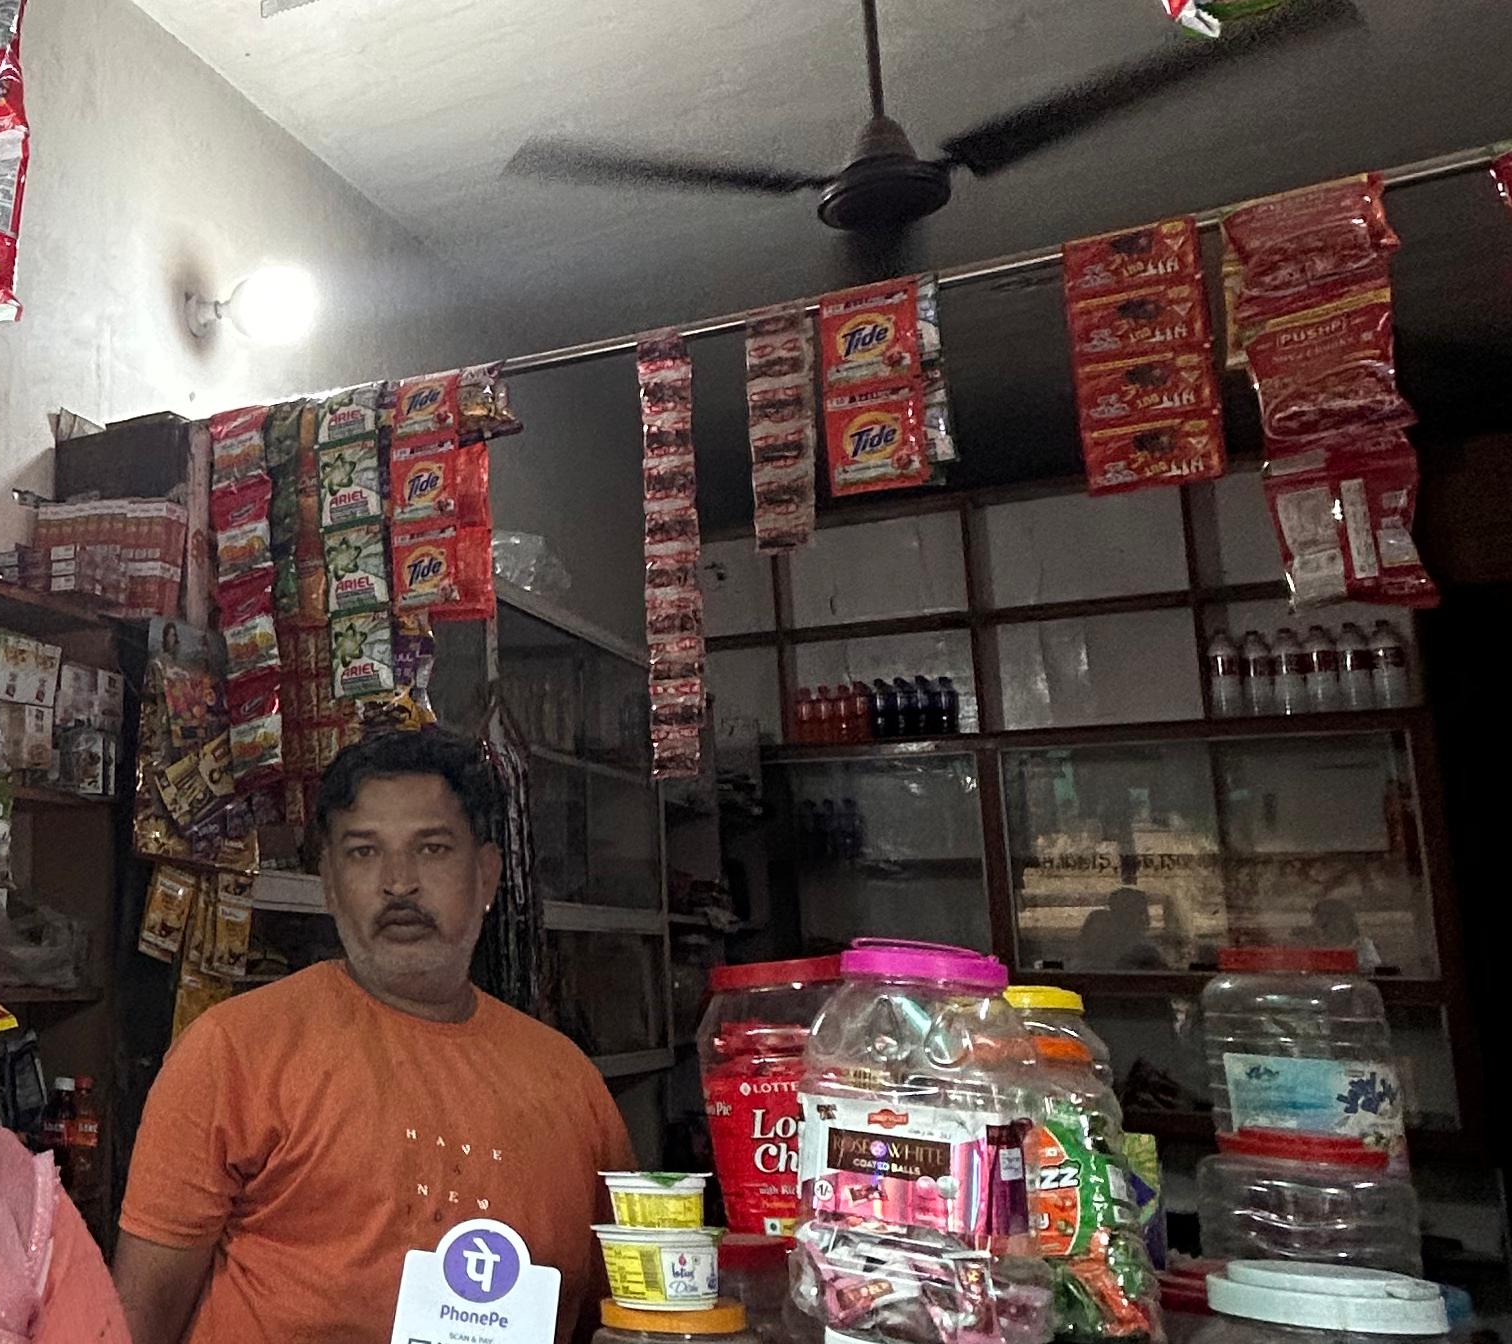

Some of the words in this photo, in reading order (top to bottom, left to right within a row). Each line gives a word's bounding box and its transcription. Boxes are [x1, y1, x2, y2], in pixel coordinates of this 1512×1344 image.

[841, 323, 889, 359] Tide
[403, 386, 447, 415] Tide
[327, 408, 366, 426] ARIEL
[849, 424, 898, 459] Tide
[1168, 457, 1205, 477] HIT
[328, 490, 369, 508] ARIEL
[406, 472, 441, 502] Tide
[336, 576, 375, 592] ARIEL
[406, 557, 444, 587] Tide
[340, 662, 380, 679] ARIEL
[404, 1125, 504, 1163] HAVE
[890, 1142, 947, 1165] WHITE
[851, 1157, 890, 1173] COATED
[890, 1161, 921, 1177] BALLS
[416, 1181, 491, 1212] NEW
[462, 1237, 502, 1294] पे
[439, 1303, 510, 1331] PhonePe
[448, 1331, 469, 1344] SCAN
